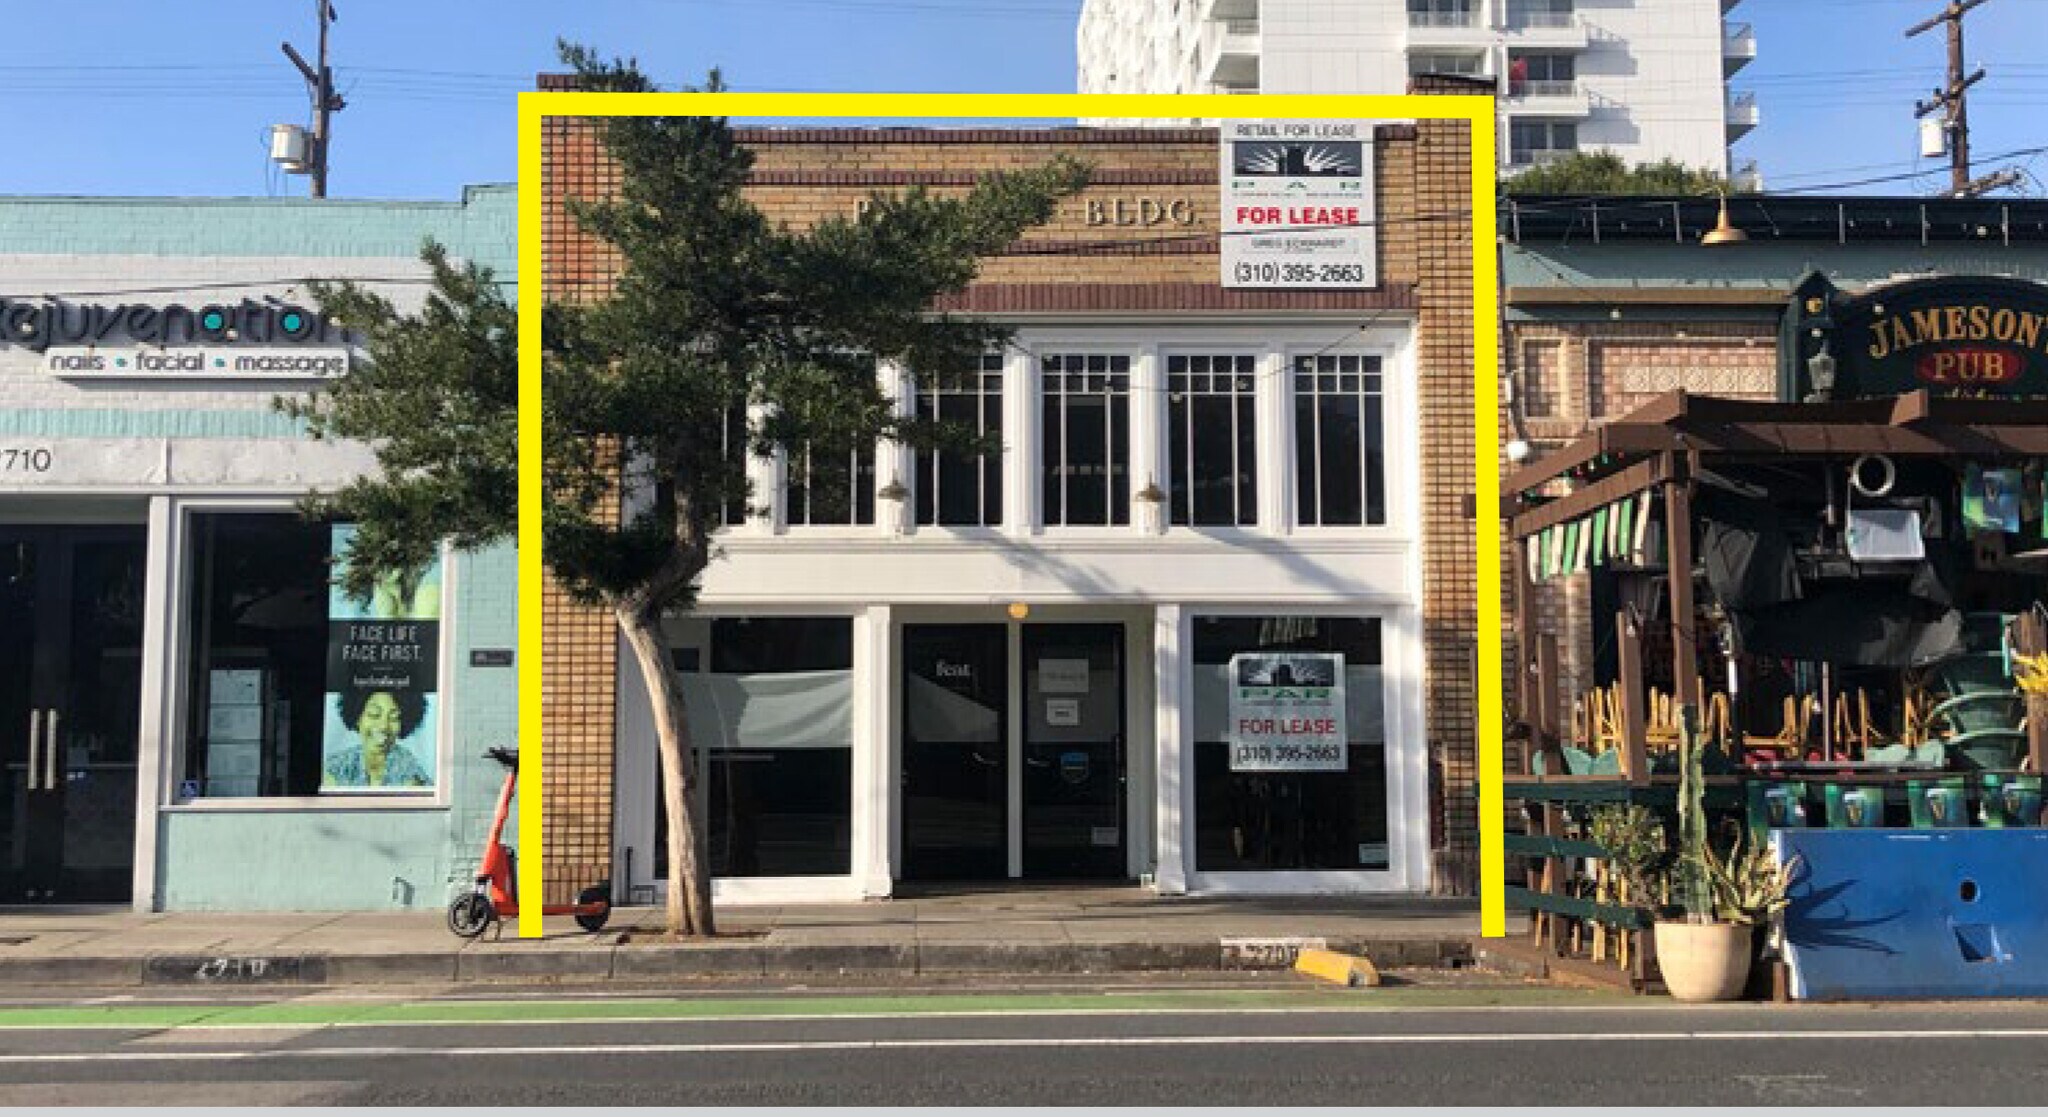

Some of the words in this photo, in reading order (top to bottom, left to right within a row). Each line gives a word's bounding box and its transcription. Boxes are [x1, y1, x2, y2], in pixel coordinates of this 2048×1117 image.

[1236, 123, 1277, 137] RETAIL
[1284, 123, 1310, 137] FOR
[1314, 123, 1357, 137] LEASE
[1085, 197, 1203, 226] BLDG.
[1236, 206, 1282, 225] FOR
[1288, 206, 1360, 225] LEASE
[1234, 261, 1280, 284] (310)
[1281, 262, 1364, 282] 395-2663
[0, 294, 350, 356] ejuvenation
[50, 351, 106, 371] nails
[135, 350, 205, 371] facial
[235, 354, 344, 376] massage
[1932, 352, 2004, 380] PUB
[0, 449, 51, 472] 710
[350, 625, 384, 641] FACE
[342, 644, 377, 661] FACE
[1239, 718, 1275, 734] FOR
[1281, 718, 1337, 734] LEASE
